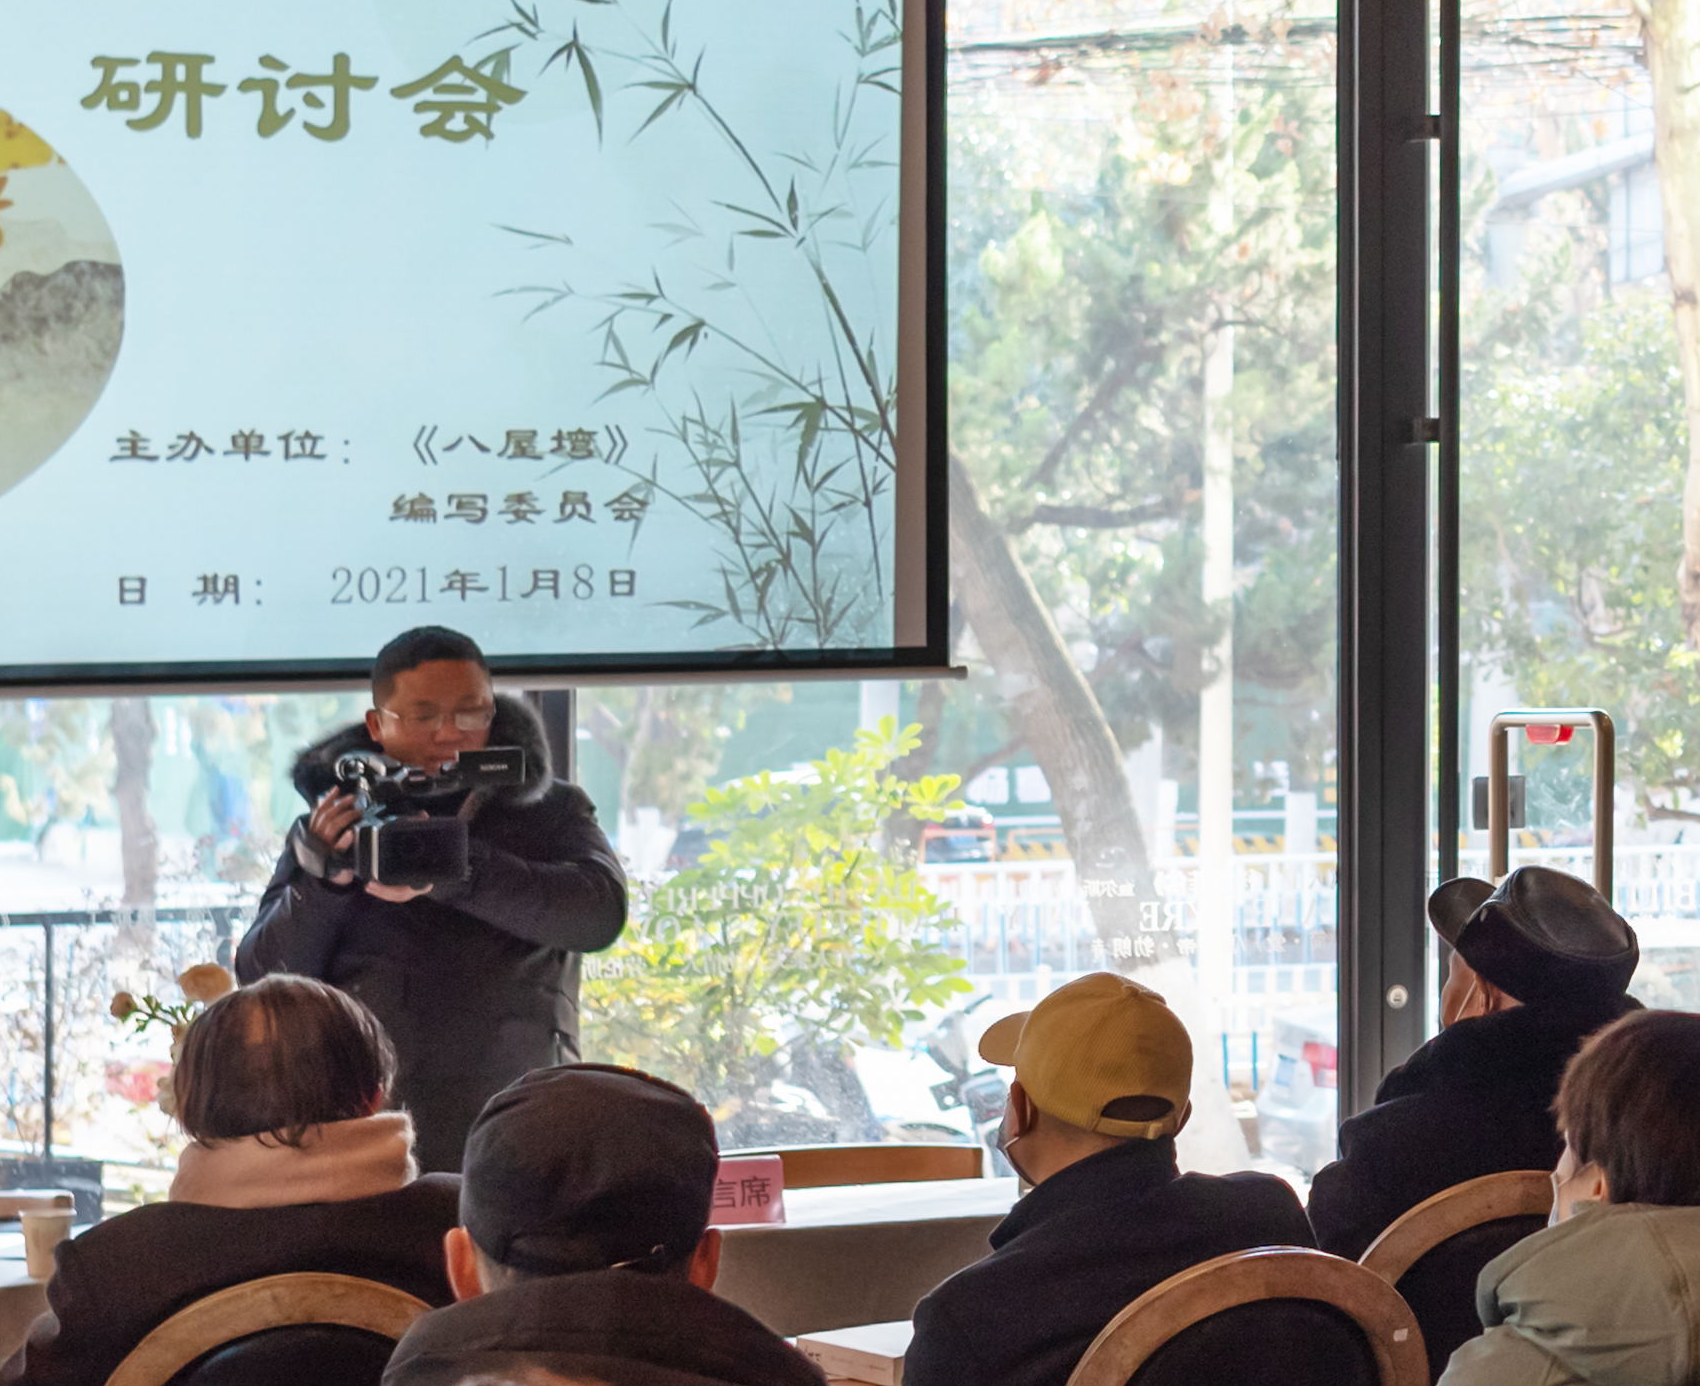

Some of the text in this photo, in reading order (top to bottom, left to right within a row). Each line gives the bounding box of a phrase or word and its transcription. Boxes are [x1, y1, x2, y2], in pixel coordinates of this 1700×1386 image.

[81, 51, 529, 144] 研讨会
[388, 490, 649, 525] 编写委员会
[330, 564, 638, 605] 2021年1月8日
